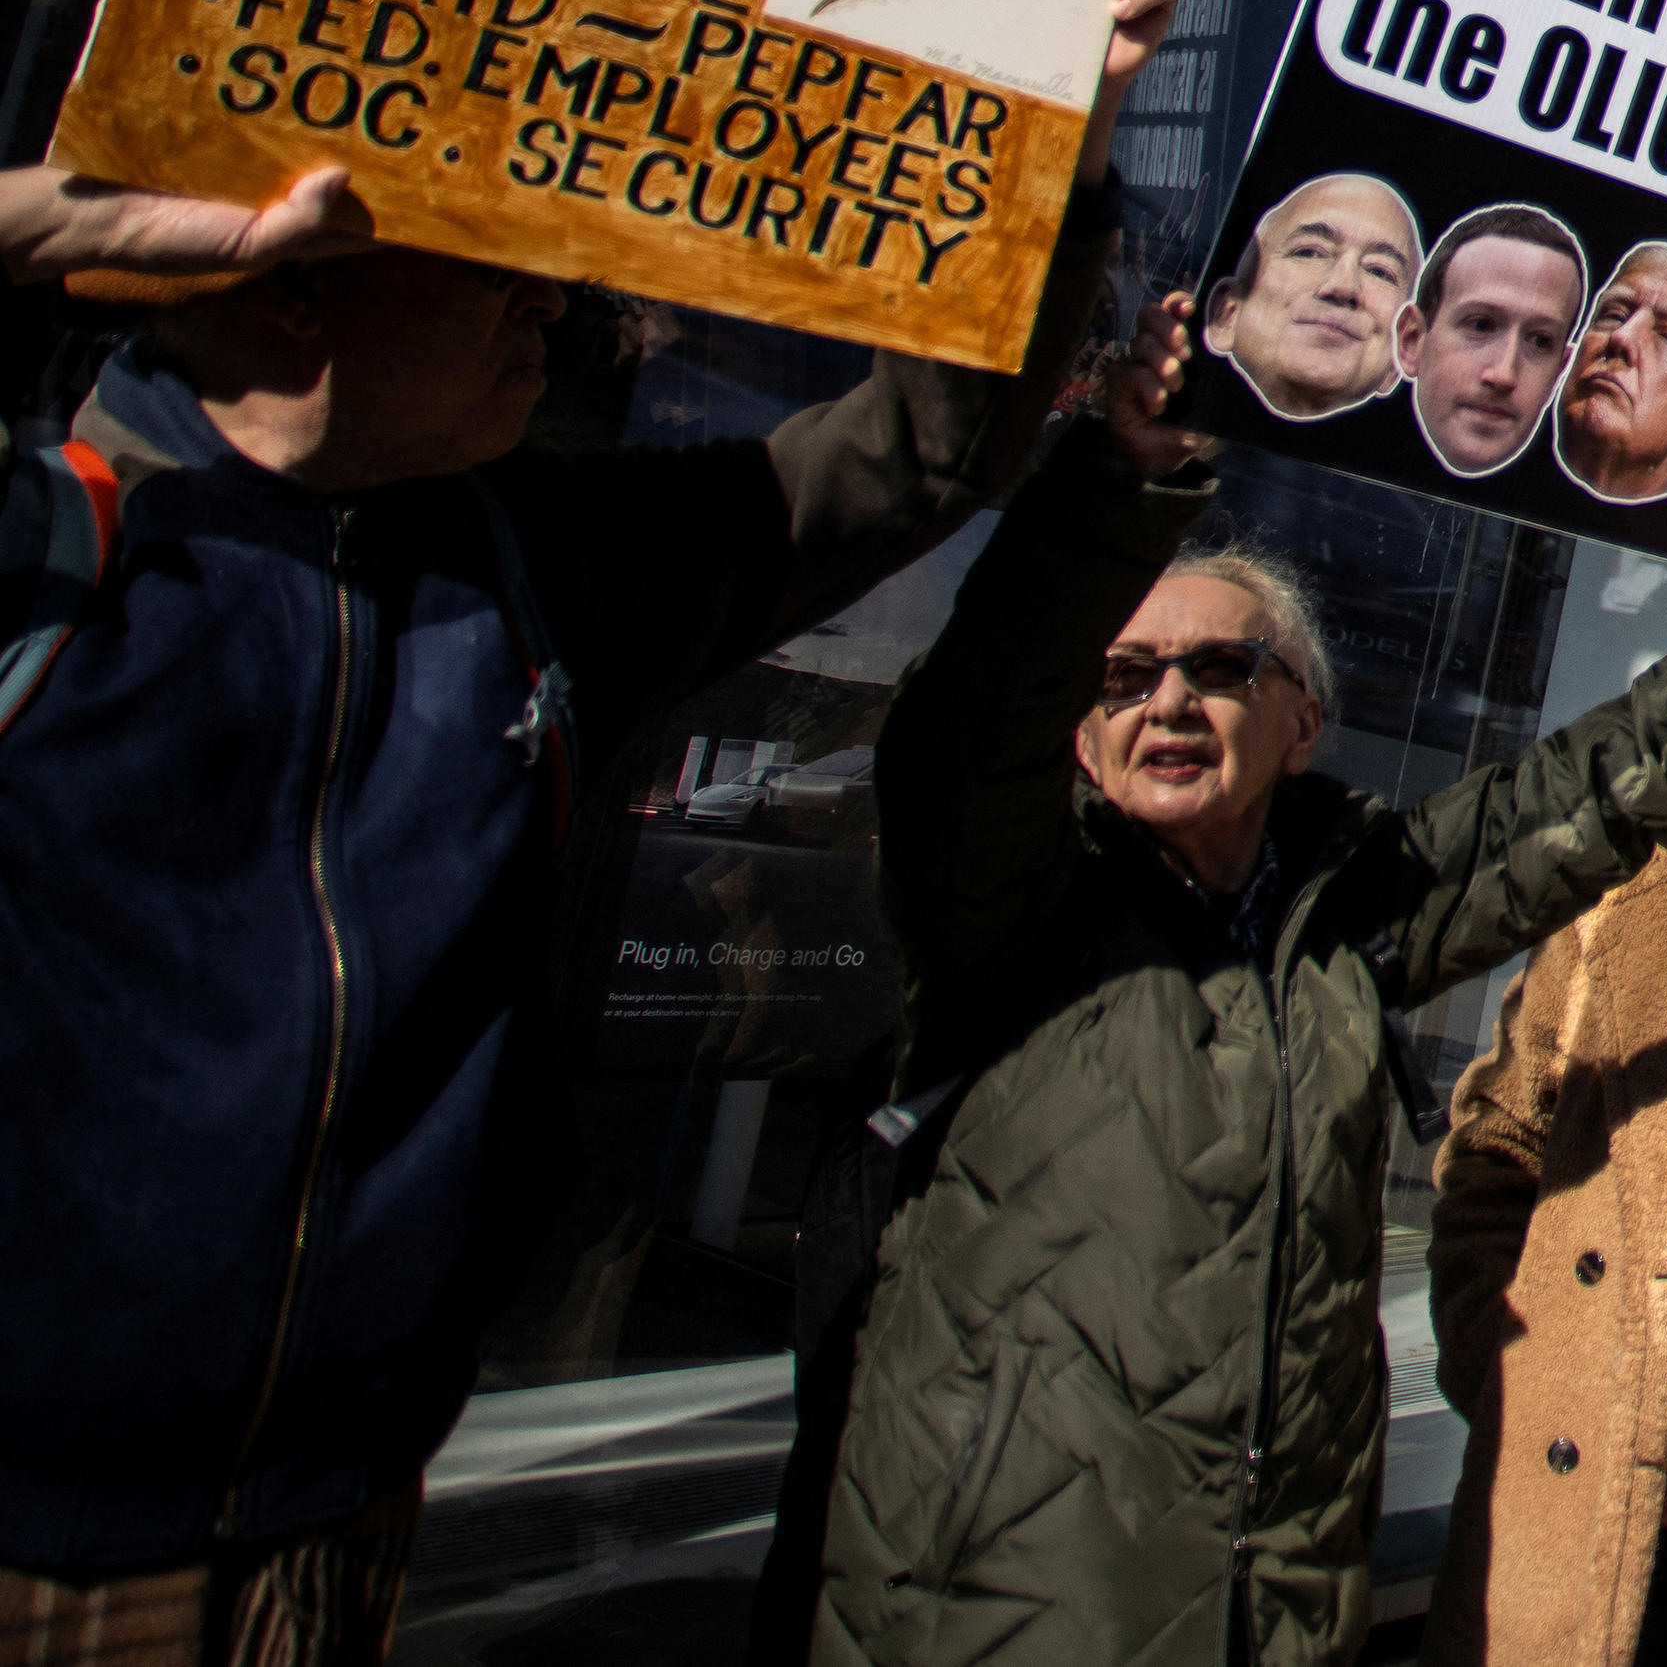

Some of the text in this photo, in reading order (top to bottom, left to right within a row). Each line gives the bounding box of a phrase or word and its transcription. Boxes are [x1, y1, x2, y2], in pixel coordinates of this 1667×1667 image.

[462, 29, 993, 221] EMPLOYEES
[680, 14, 1008, 158] PEPFAR
[507, 116, 969, 285] SECURITY
[1322, 627, 1427, 662] ODEL
[617, 940, 866, 971] Plug in, Charge and Go
